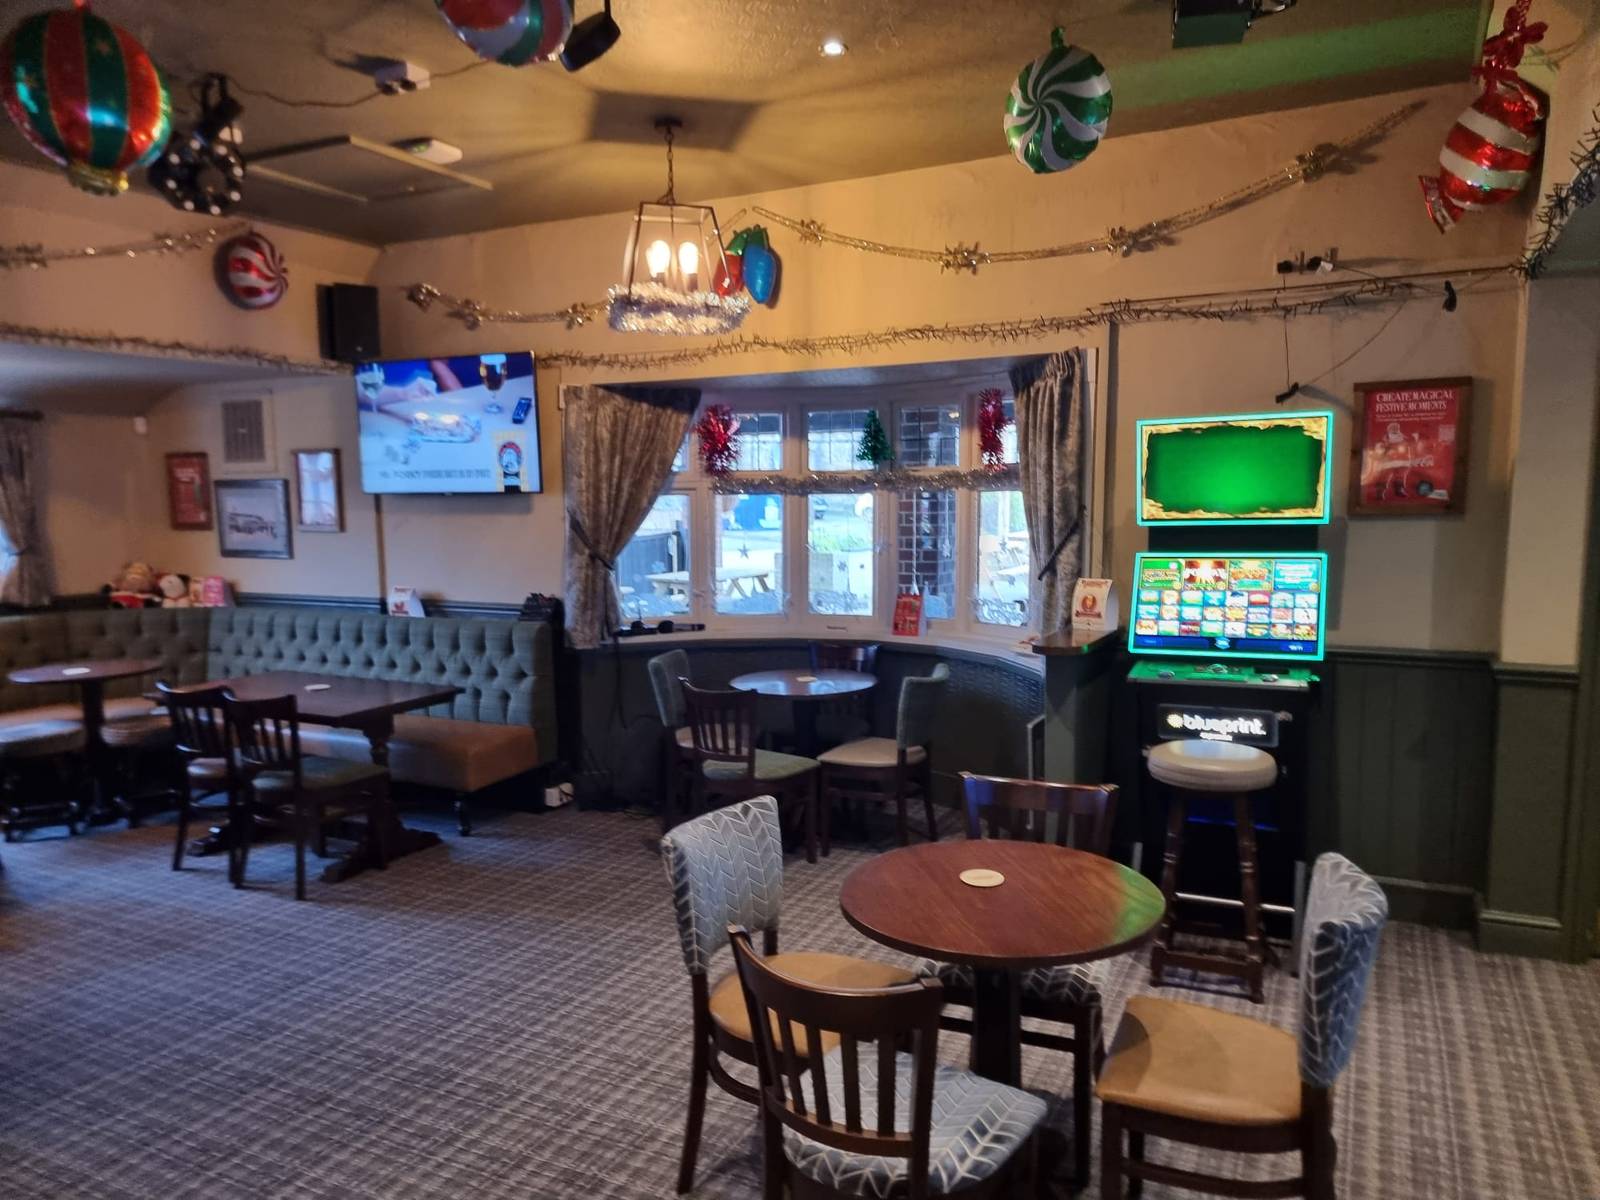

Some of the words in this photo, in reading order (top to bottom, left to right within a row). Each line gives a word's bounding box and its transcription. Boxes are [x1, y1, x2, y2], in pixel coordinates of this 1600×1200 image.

[1376, 391, 1411, 402] CREATE
[1412, 389, 1453, 400] MAGICAL
[1375, 402, 1406, 413] FESTIVE
[1408, 401, 1447, 411] MOMENTS
